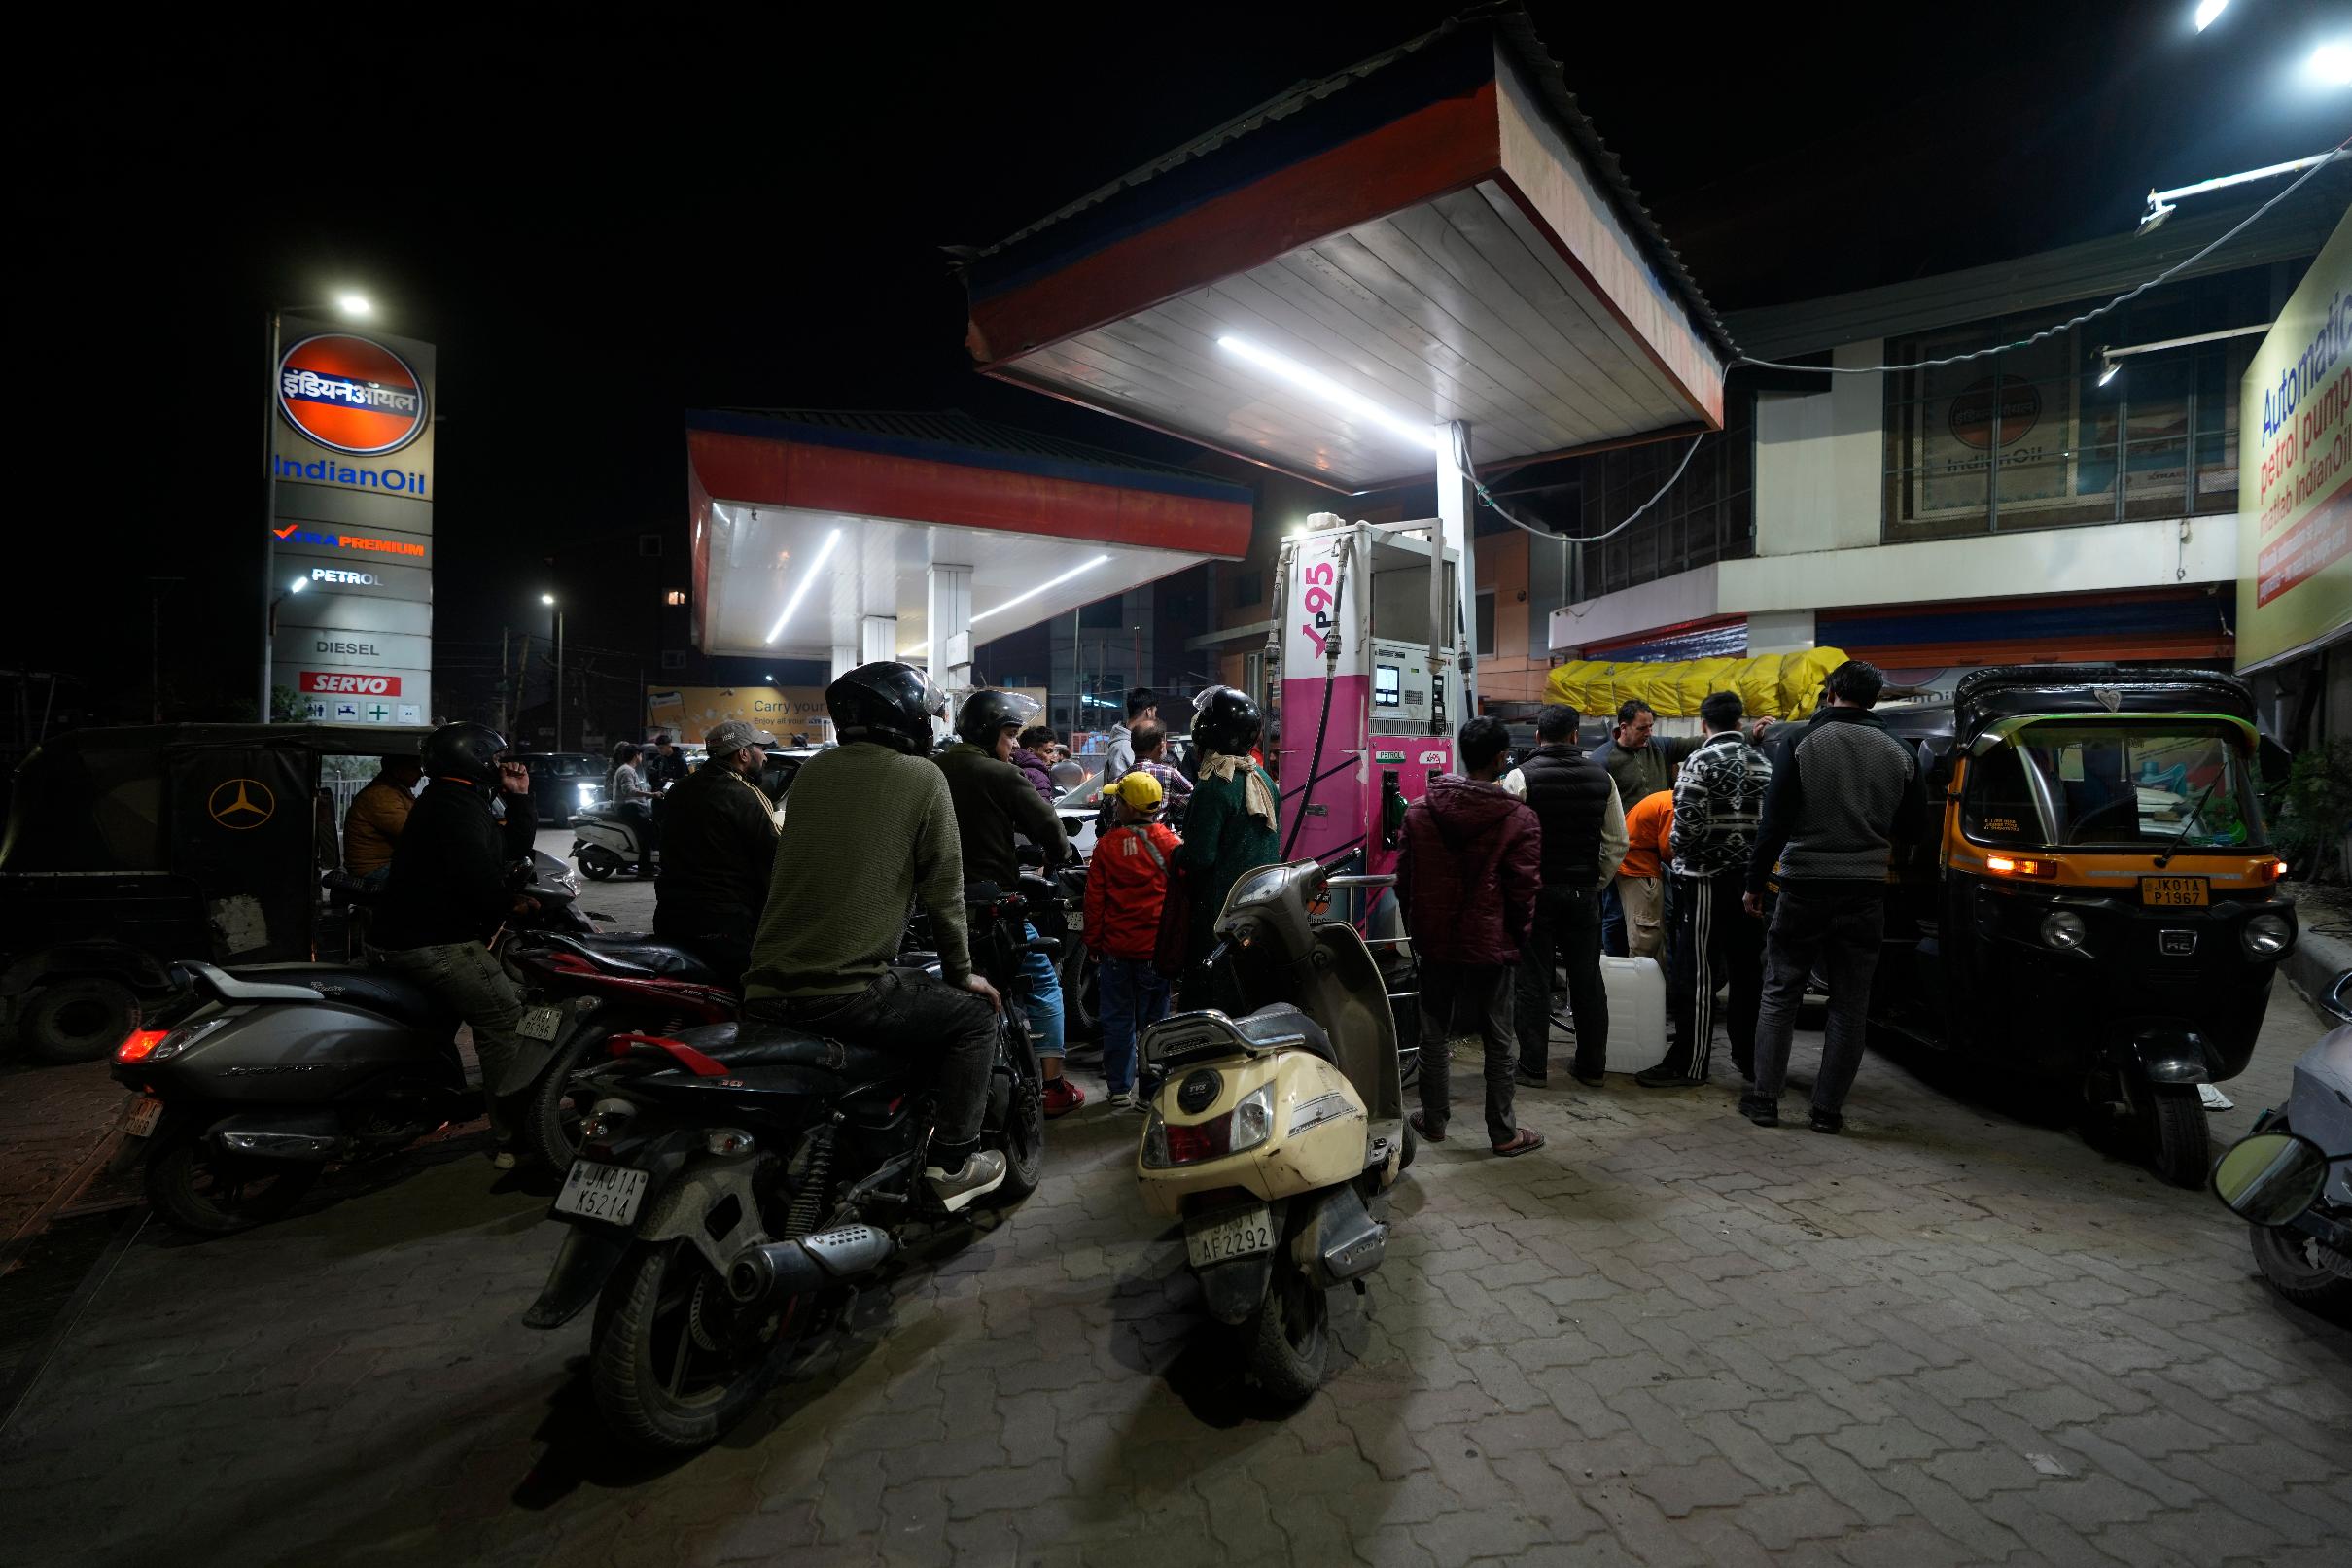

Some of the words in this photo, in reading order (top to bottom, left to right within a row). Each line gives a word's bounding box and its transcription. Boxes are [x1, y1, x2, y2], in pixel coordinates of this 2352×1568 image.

[283, 369, 415, 412] इंडियनऑयल
[2261, 413, 2299, 505] petrol
[2302, 366, 2352, 464] pump
[274, 454, 425, 494] IndianOil
[2295, 422, 2352, 507] IndianOil
[312, 568, 384, 586] PETROL
[317, 641, 380, 656] DIESEL
[313, 674, 389, 693] SERVO
[754, 700, 790, 714] Carry
[793, 702, 825, 714] your
[754, 717, 775, 726] Enjoy
[2155, 879, 2199, 891] JK01A
[2155, 891, 2199, 904] P1967
[586, 1166, 638, 1196] JK01A
[576, 1189, 629, 1217] K5214
[1204, 1227, 1269, 1260] AF2292
